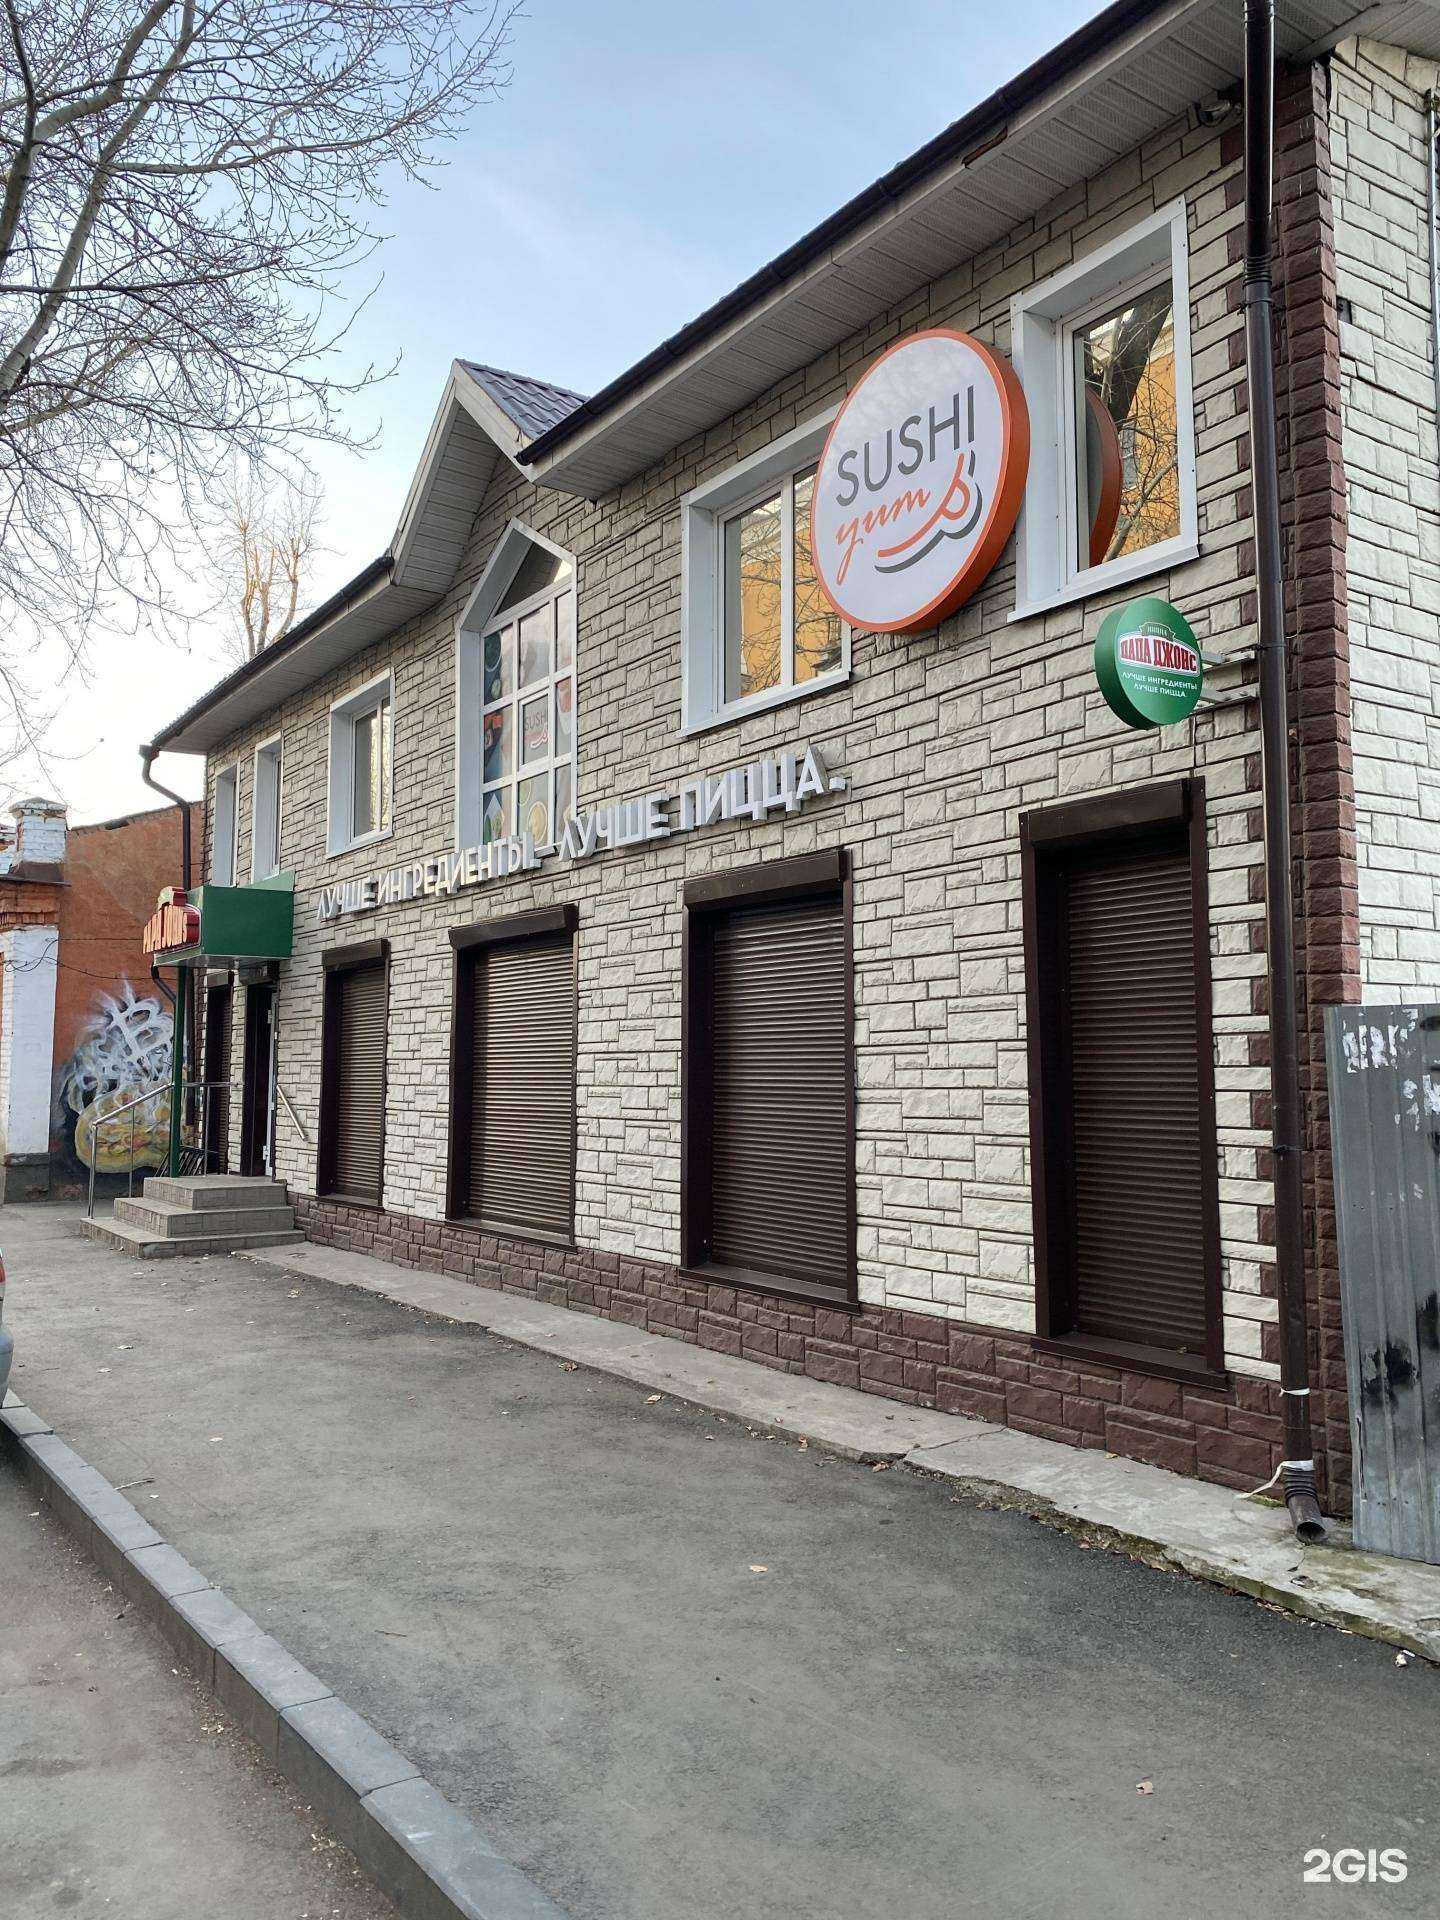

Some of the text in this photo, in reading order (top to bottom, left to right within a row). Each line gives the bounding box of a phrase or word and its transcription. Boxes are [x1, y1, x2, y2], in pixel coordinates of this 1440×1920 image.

[836, 384, 975, 507] SUSHI
[836, 488, 931, 586] yum
[1121, 638, 1197, 671] ПАПА ДЖОНС
[1122, 671, 1197, 690] ЛУЧШЕ ИНГРЕДИЕНТЫ
[1133, 683, 1186, 698] ЛУЧШЕ ПИЦЦА
[317, 875, 378, 920] ЛУЧШЕ
[558, 791, 671, 862] ЛУЧШЕ
